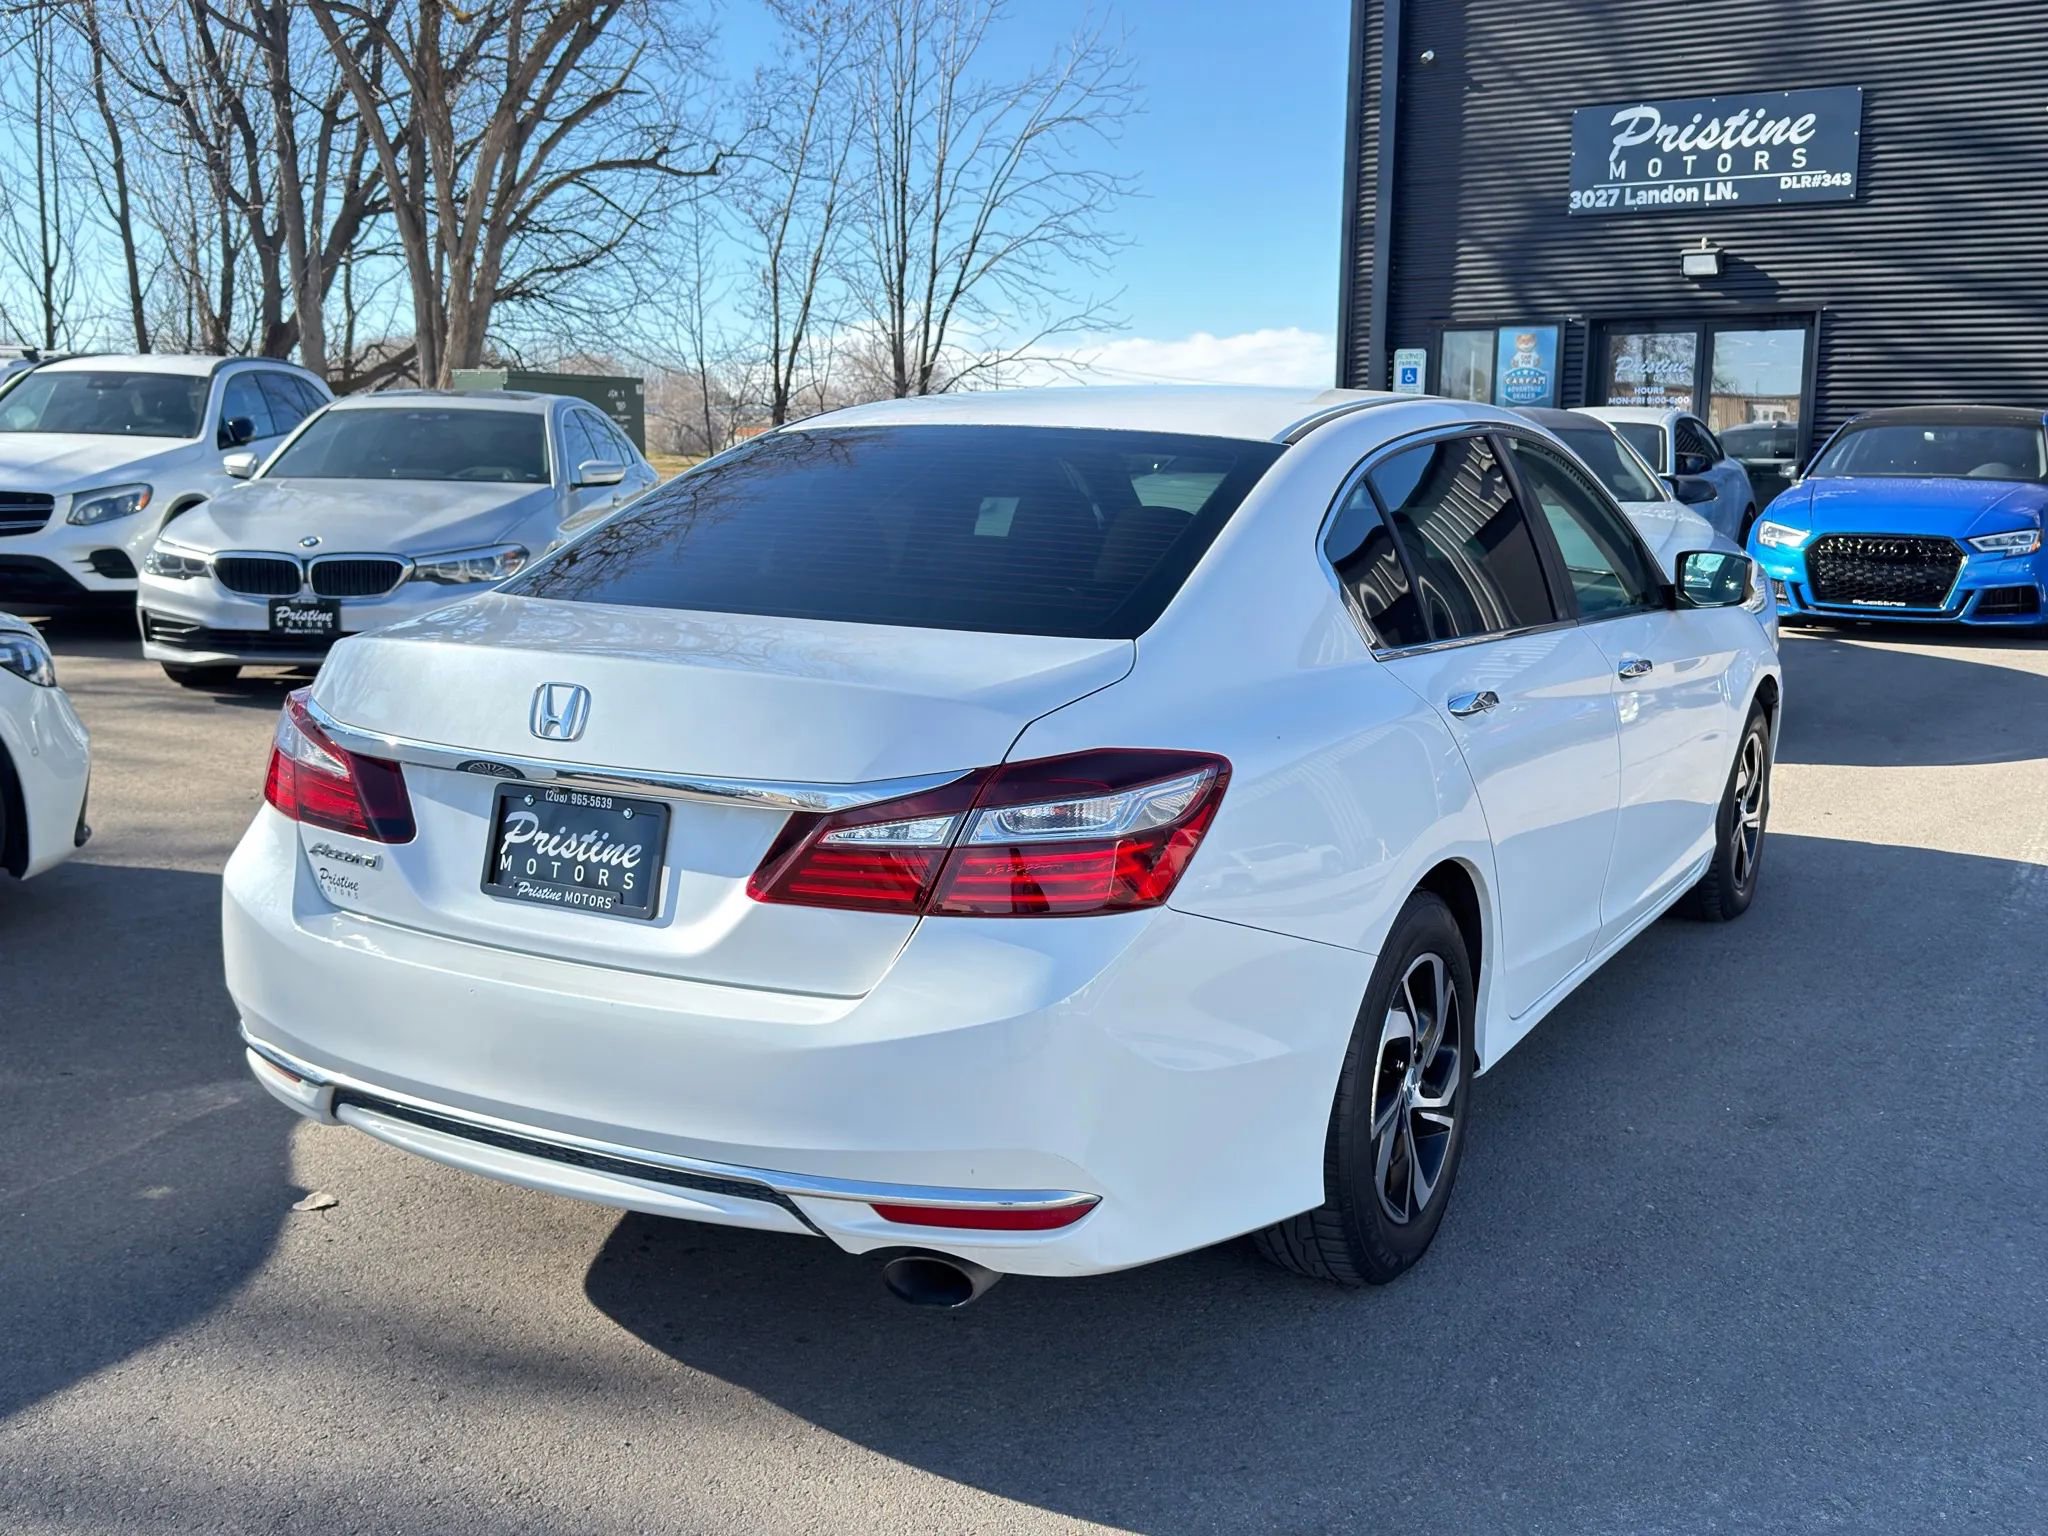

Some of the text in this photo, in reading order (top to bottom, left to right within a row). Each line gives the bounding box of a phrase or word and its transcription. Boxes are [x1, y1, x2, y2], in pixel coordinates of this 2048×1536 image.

[1609, 105, 1817, 161] Pristine
[1609, 148, 1807, 180] MOTORS
[1779, 172, 1852, 189] DLR#343
[1569, 181, 1739, 209] 3027 Landon LN.
[1615, 356, 1689, 378] Pristine
[1608, 397, 1645, 405] MON-FRI
[1634, 386, 1664, 394] HOURS
[275, 606, 333, 622] Pristine
[571, 792, 613, 809] 965-5639
[500, 811, 642, 868] Pristine
[319, 867, 359, 891] Pristine
[499, 854, 635, 890] MOTORS
[517, 881, 612, 909] Pristine MOTORS
